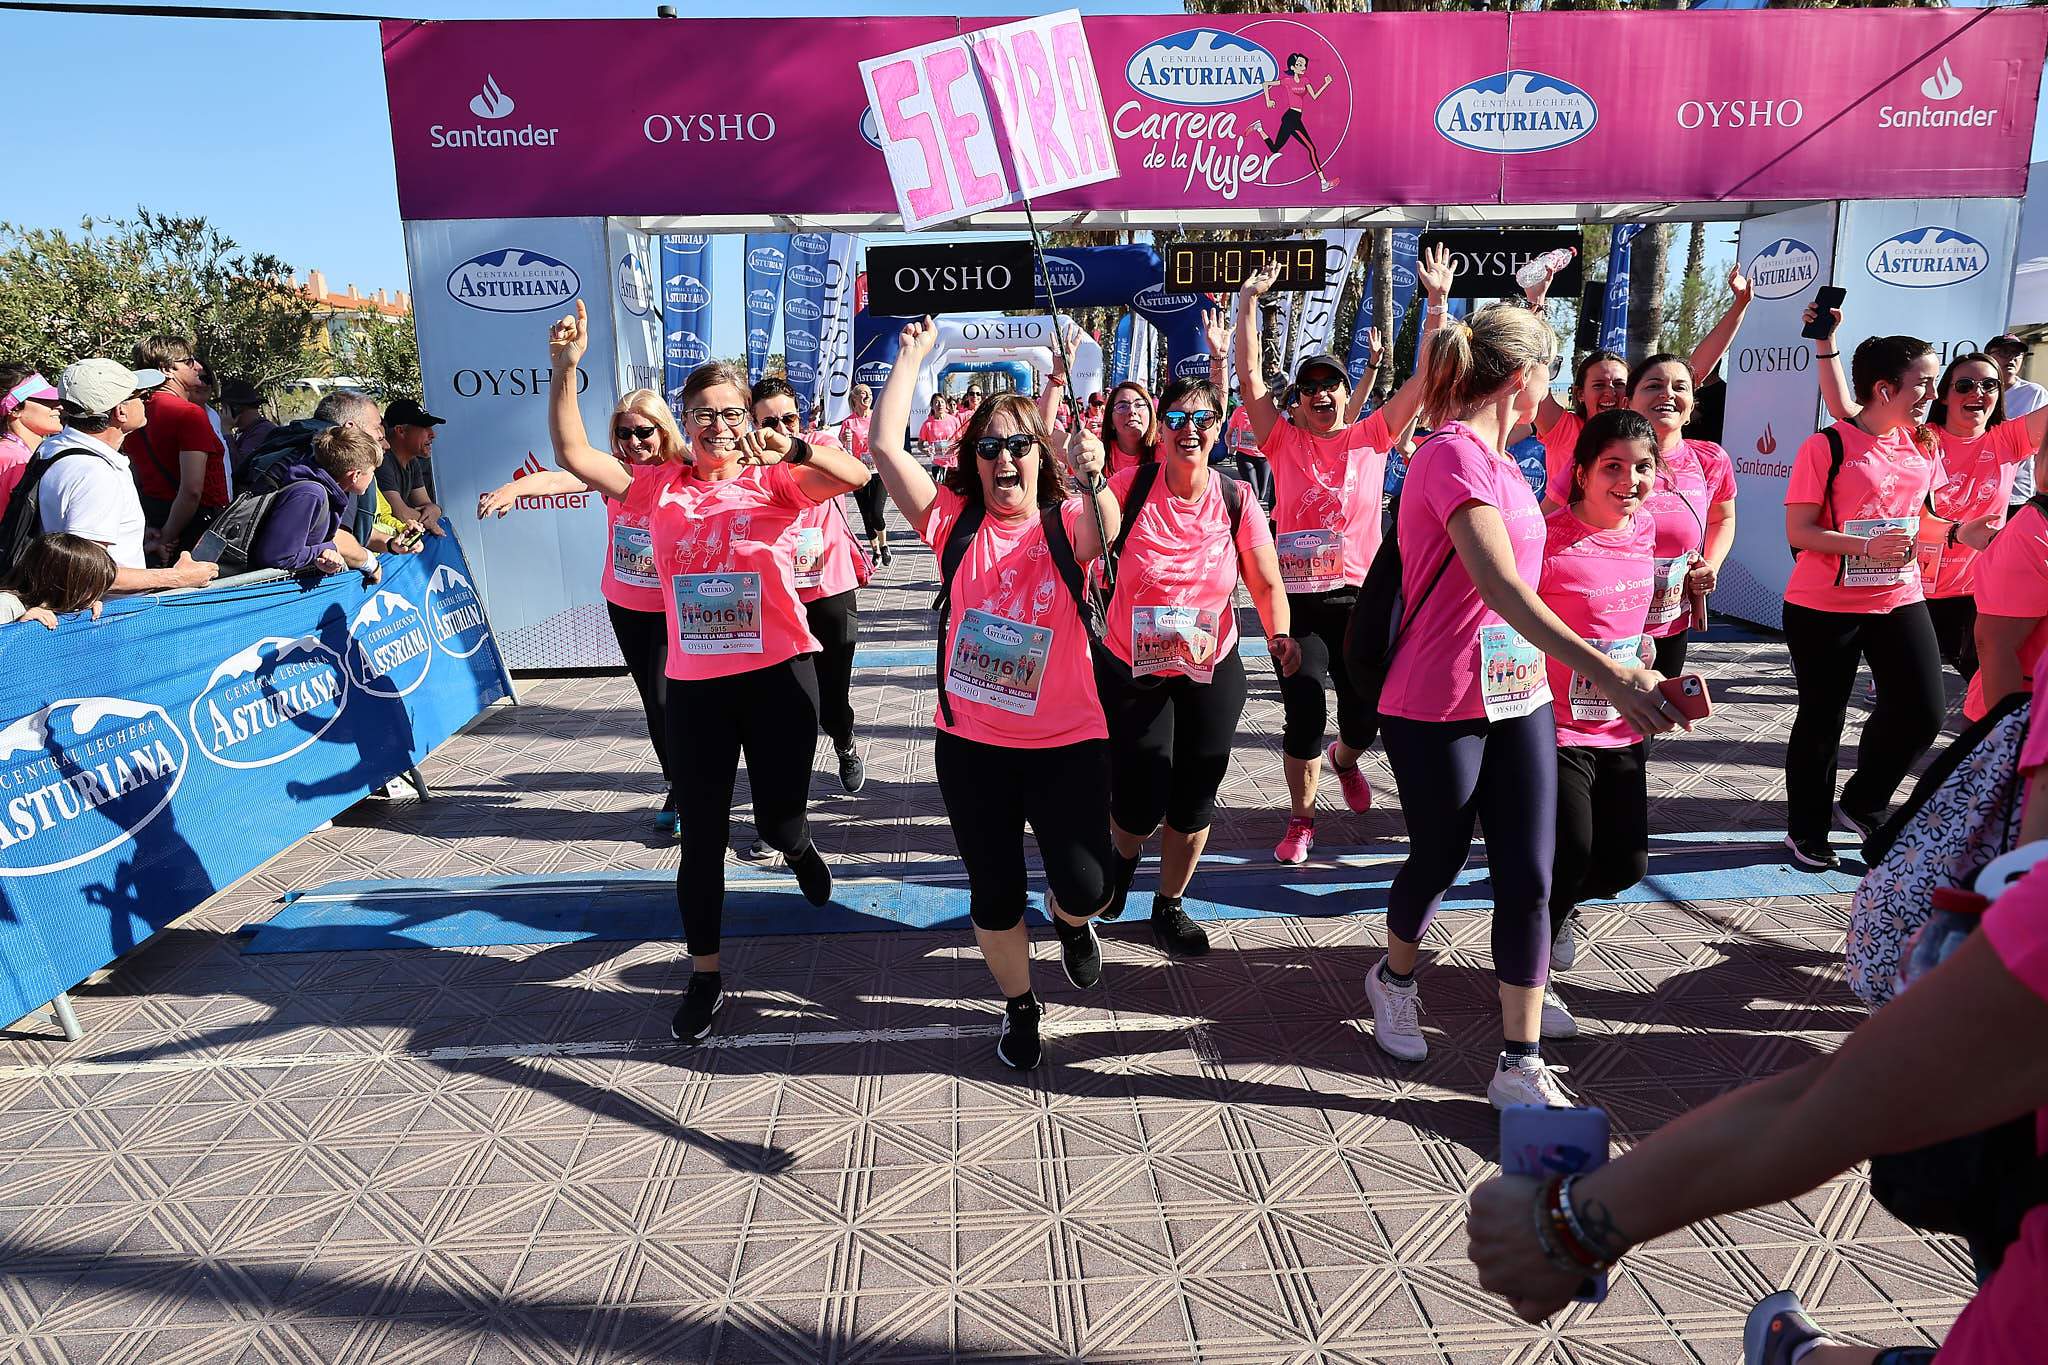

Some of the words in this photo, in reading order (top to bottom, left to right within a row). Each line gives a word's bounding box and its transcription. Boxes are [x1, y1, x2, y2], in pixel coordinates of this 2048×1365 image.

[1161, 55, 1208, 63] CENTRAL
[1213, 55, 1263, 63] LECHERA
[1138, 57, 1265, 86] ASTURIANA
[1472, 100, 1523, 108] CENTRAL
[1527, 98, 1582, 107] LECHERA
[1113, 100, 1237, 140] Carrera
[1446, 102, 1584, 133] ASTURIANA
[1677, 99, 1803, 129] OYSHO
[1878, 105, 1998, 128] Santander
[430, 123, 559, 149] Santander
[643, 111, 776, 144] OYSHO
[1143, 142, 1166, 169] de
[1171, 141, 1188, 169] la
[1184, 135, 1282, 200] Mujer
[1874, 250, 1979, 273] ASTURIANA
[458, 273, 572, 298] ASTURIANA
[476, 271, 520, 279] CENTRAL
[790, 270, 823, 284] ASTURIANA
[894, 264, 1012, 293] OYSHO
[1753, 264, 1812, 286] ASTURIANA
[1139, 294, 1194, 307] ASTURIANA
[963, 323, 1042, 340] OYSHO
[1739, 345, 1809, 373] OYSHO
[1179, 365, 1210, 375] ASTURI
[1736, 457, 1793, 478] Santander
[629, 553, 653, 567] 016
[1296, 557, 1321, 569] 016
[1851, 575, 1879, 583] OYSHO
[1581, 586, 1615, 599] Sports
[1655, 584, 1681, 599] 016
[432, 604, 482, 643] ASTURIAN
[702, 609, 736, 623] 016
[984, 626, 1021, 644] ASTURIANA
[358, 627, 429, 684] ASTURIANA
[978, 654, 1015, 675] 016
[225, 675, 278, 702] CENTRAL
[280, 654, 329, 680] LECHERA
[1515, 660, 1538, 680] 016
[952, 670, 972, 683] CARRERA
[971, 677, 979, 685] DE
[978, 679, 986, 687] LA
[986, 682, 1006, 692] MUJER
[1008, 687, 1033, 698] VALENCIA
[954, 682, 979, 697] OYSHO
[1488, 694, 1511, 703] CARRERA
[208, 670, 342, 753] ASTURIANA
[1576, 708, 1608, 716] OYSHO
[0, 749, 81, 790] CENTRAL
[86, 720, 155, 756] LECHERA
